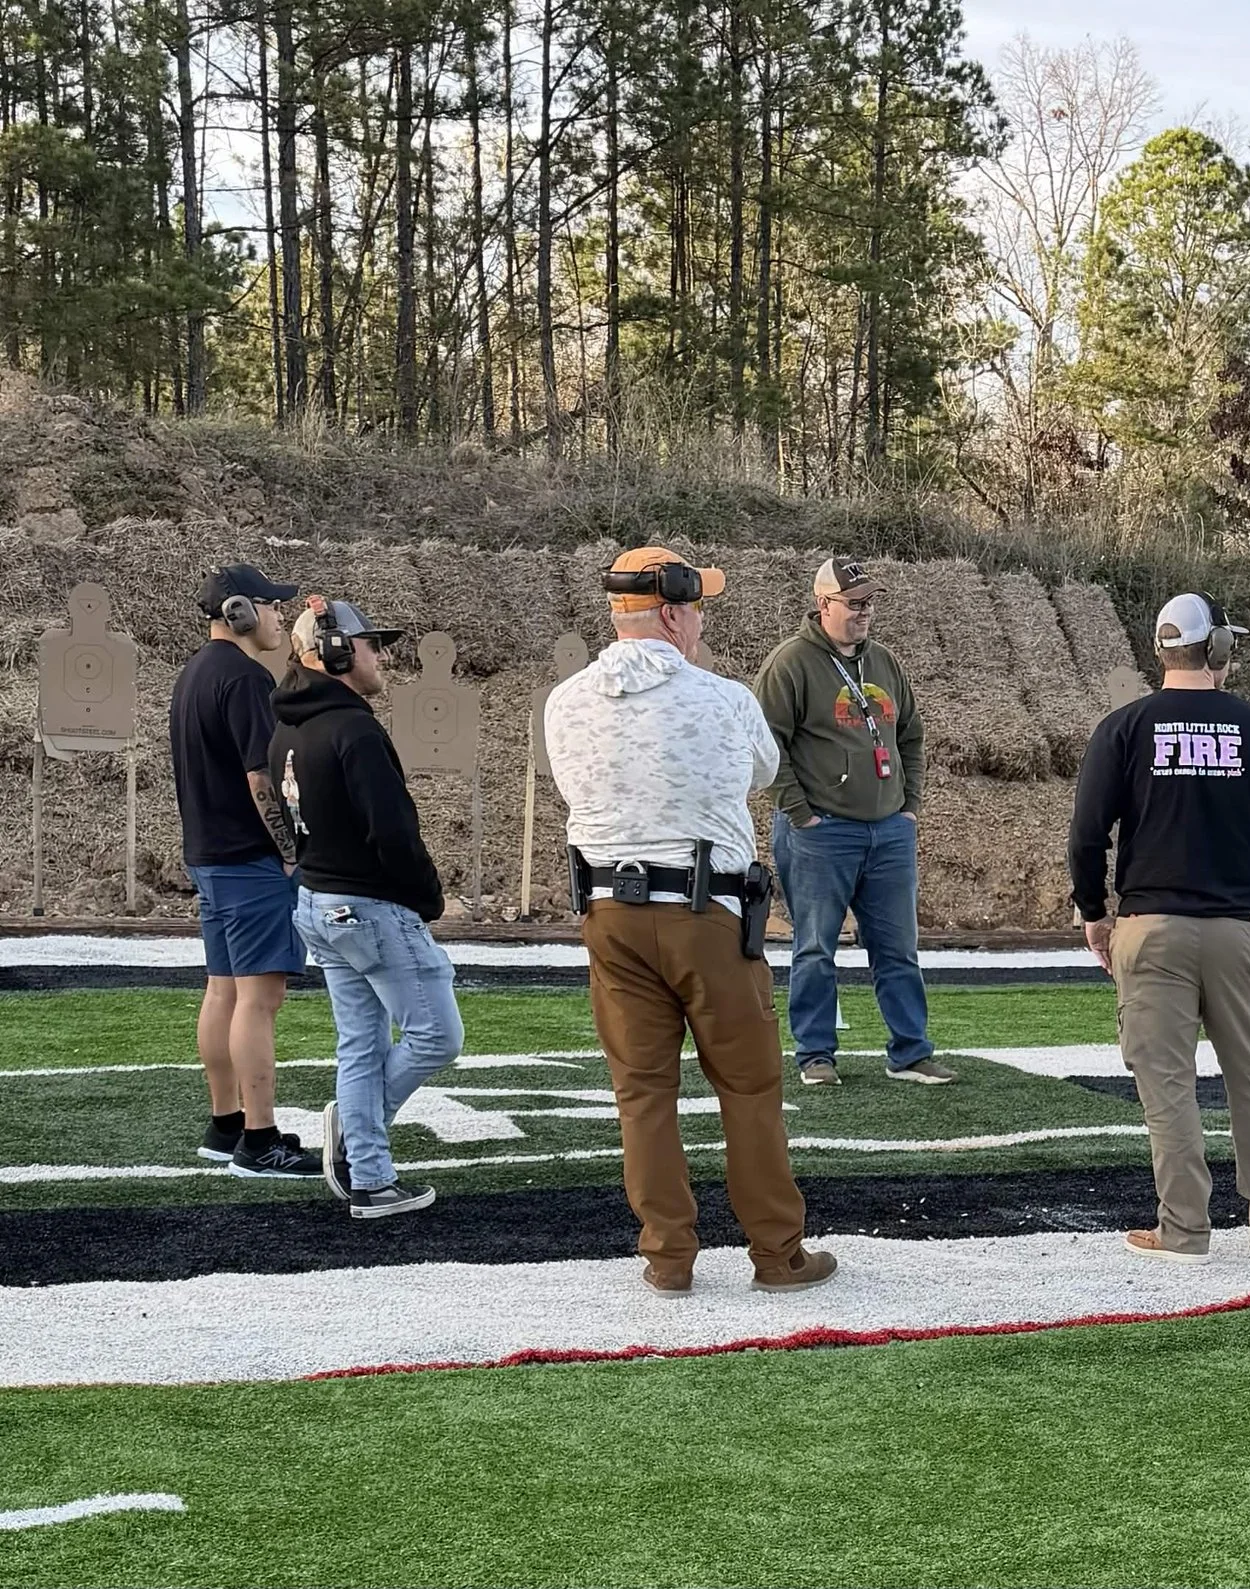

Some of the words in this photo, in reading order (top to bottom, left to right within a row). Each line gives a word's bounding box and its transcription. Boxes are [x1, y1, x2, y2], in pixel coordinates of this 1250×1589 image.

[1154, 722, 1185, 733] NORTH
[1185, 722, 1215, 733] LITTLE
[1216, 723, 1240, 734] ROCK
[1153, 733, 1242, 767] FIRE
